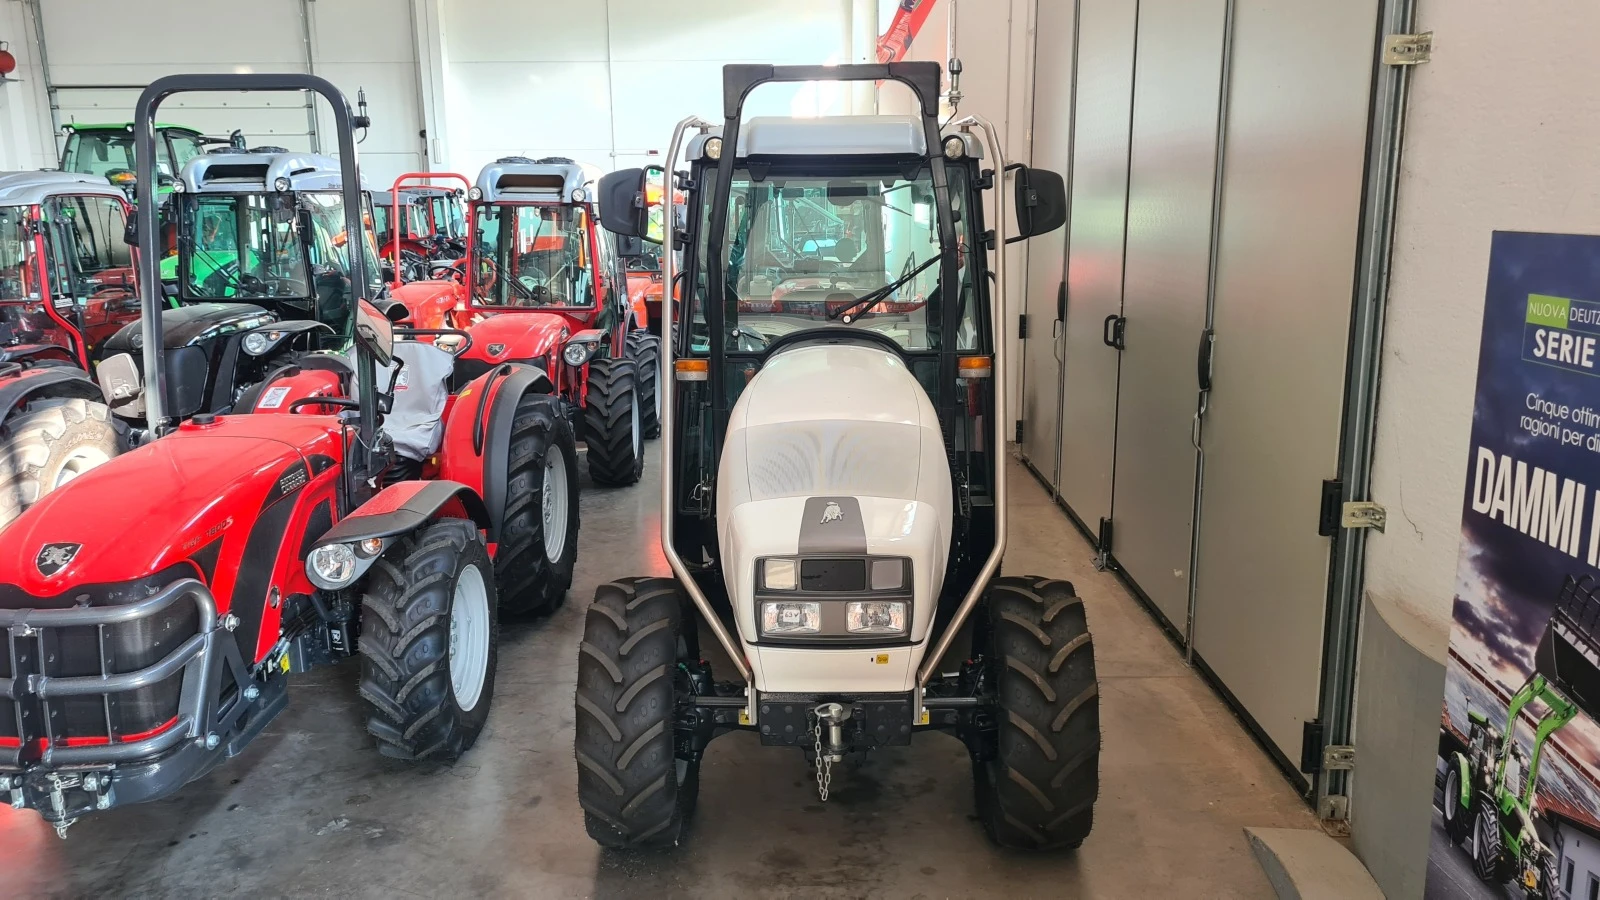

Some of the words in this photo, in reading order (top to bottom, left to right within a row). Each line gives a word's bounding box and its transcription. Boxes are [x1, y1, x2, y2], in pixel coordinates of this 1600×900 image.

[1529, 302, 1566, 320] NUOVA
[1533, 329, 1596, 368] SERIE
[1526, 393, 1569, 419] Cinque
[1520, 415, 1560, 437] ragioni
[1561, 428, 1585, 446] per
[1472, 446, 1586, 558] DAMMI
